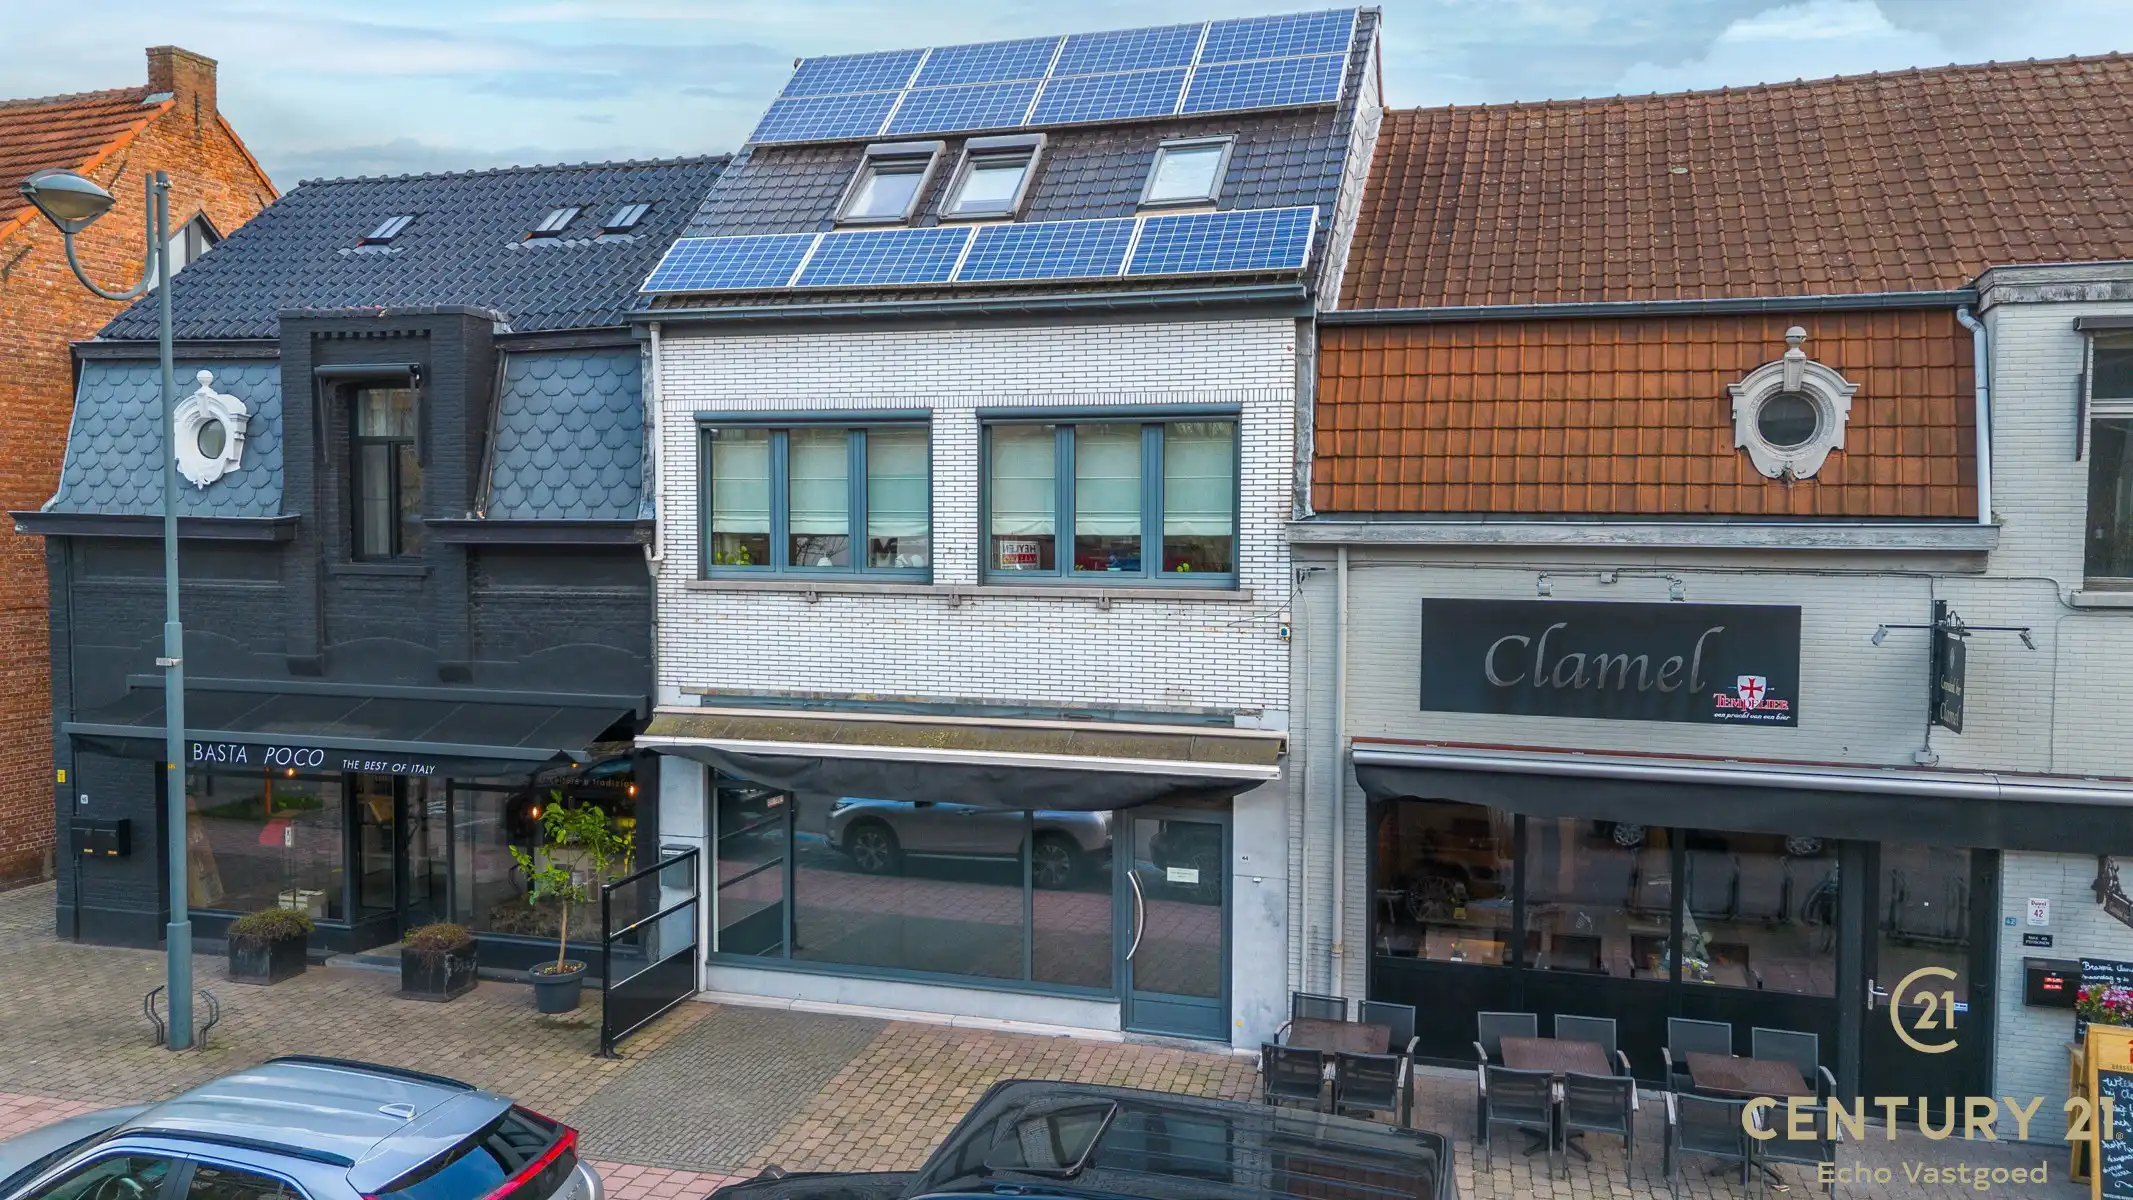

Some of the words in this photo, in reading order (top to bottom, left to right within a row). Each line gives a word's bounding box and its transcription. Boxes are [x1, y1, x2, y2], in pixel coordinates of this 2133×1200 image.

[1485, 622, 1725, 694] Clamel
[1713, 692, 1789, 711] TEMPELIER
[1776, 712, 1791, 721] bier
[193, 742, 248, 764] BASTA
[264, 746, 325, 767] POCO
[342, 759, 360, 770] THE
[364, 760, 388, 772] BEST
[392, 762, 409, 773] OF
[411, 764, 436, 775] ITALY
[2034, 909, 2044, 918] 42
